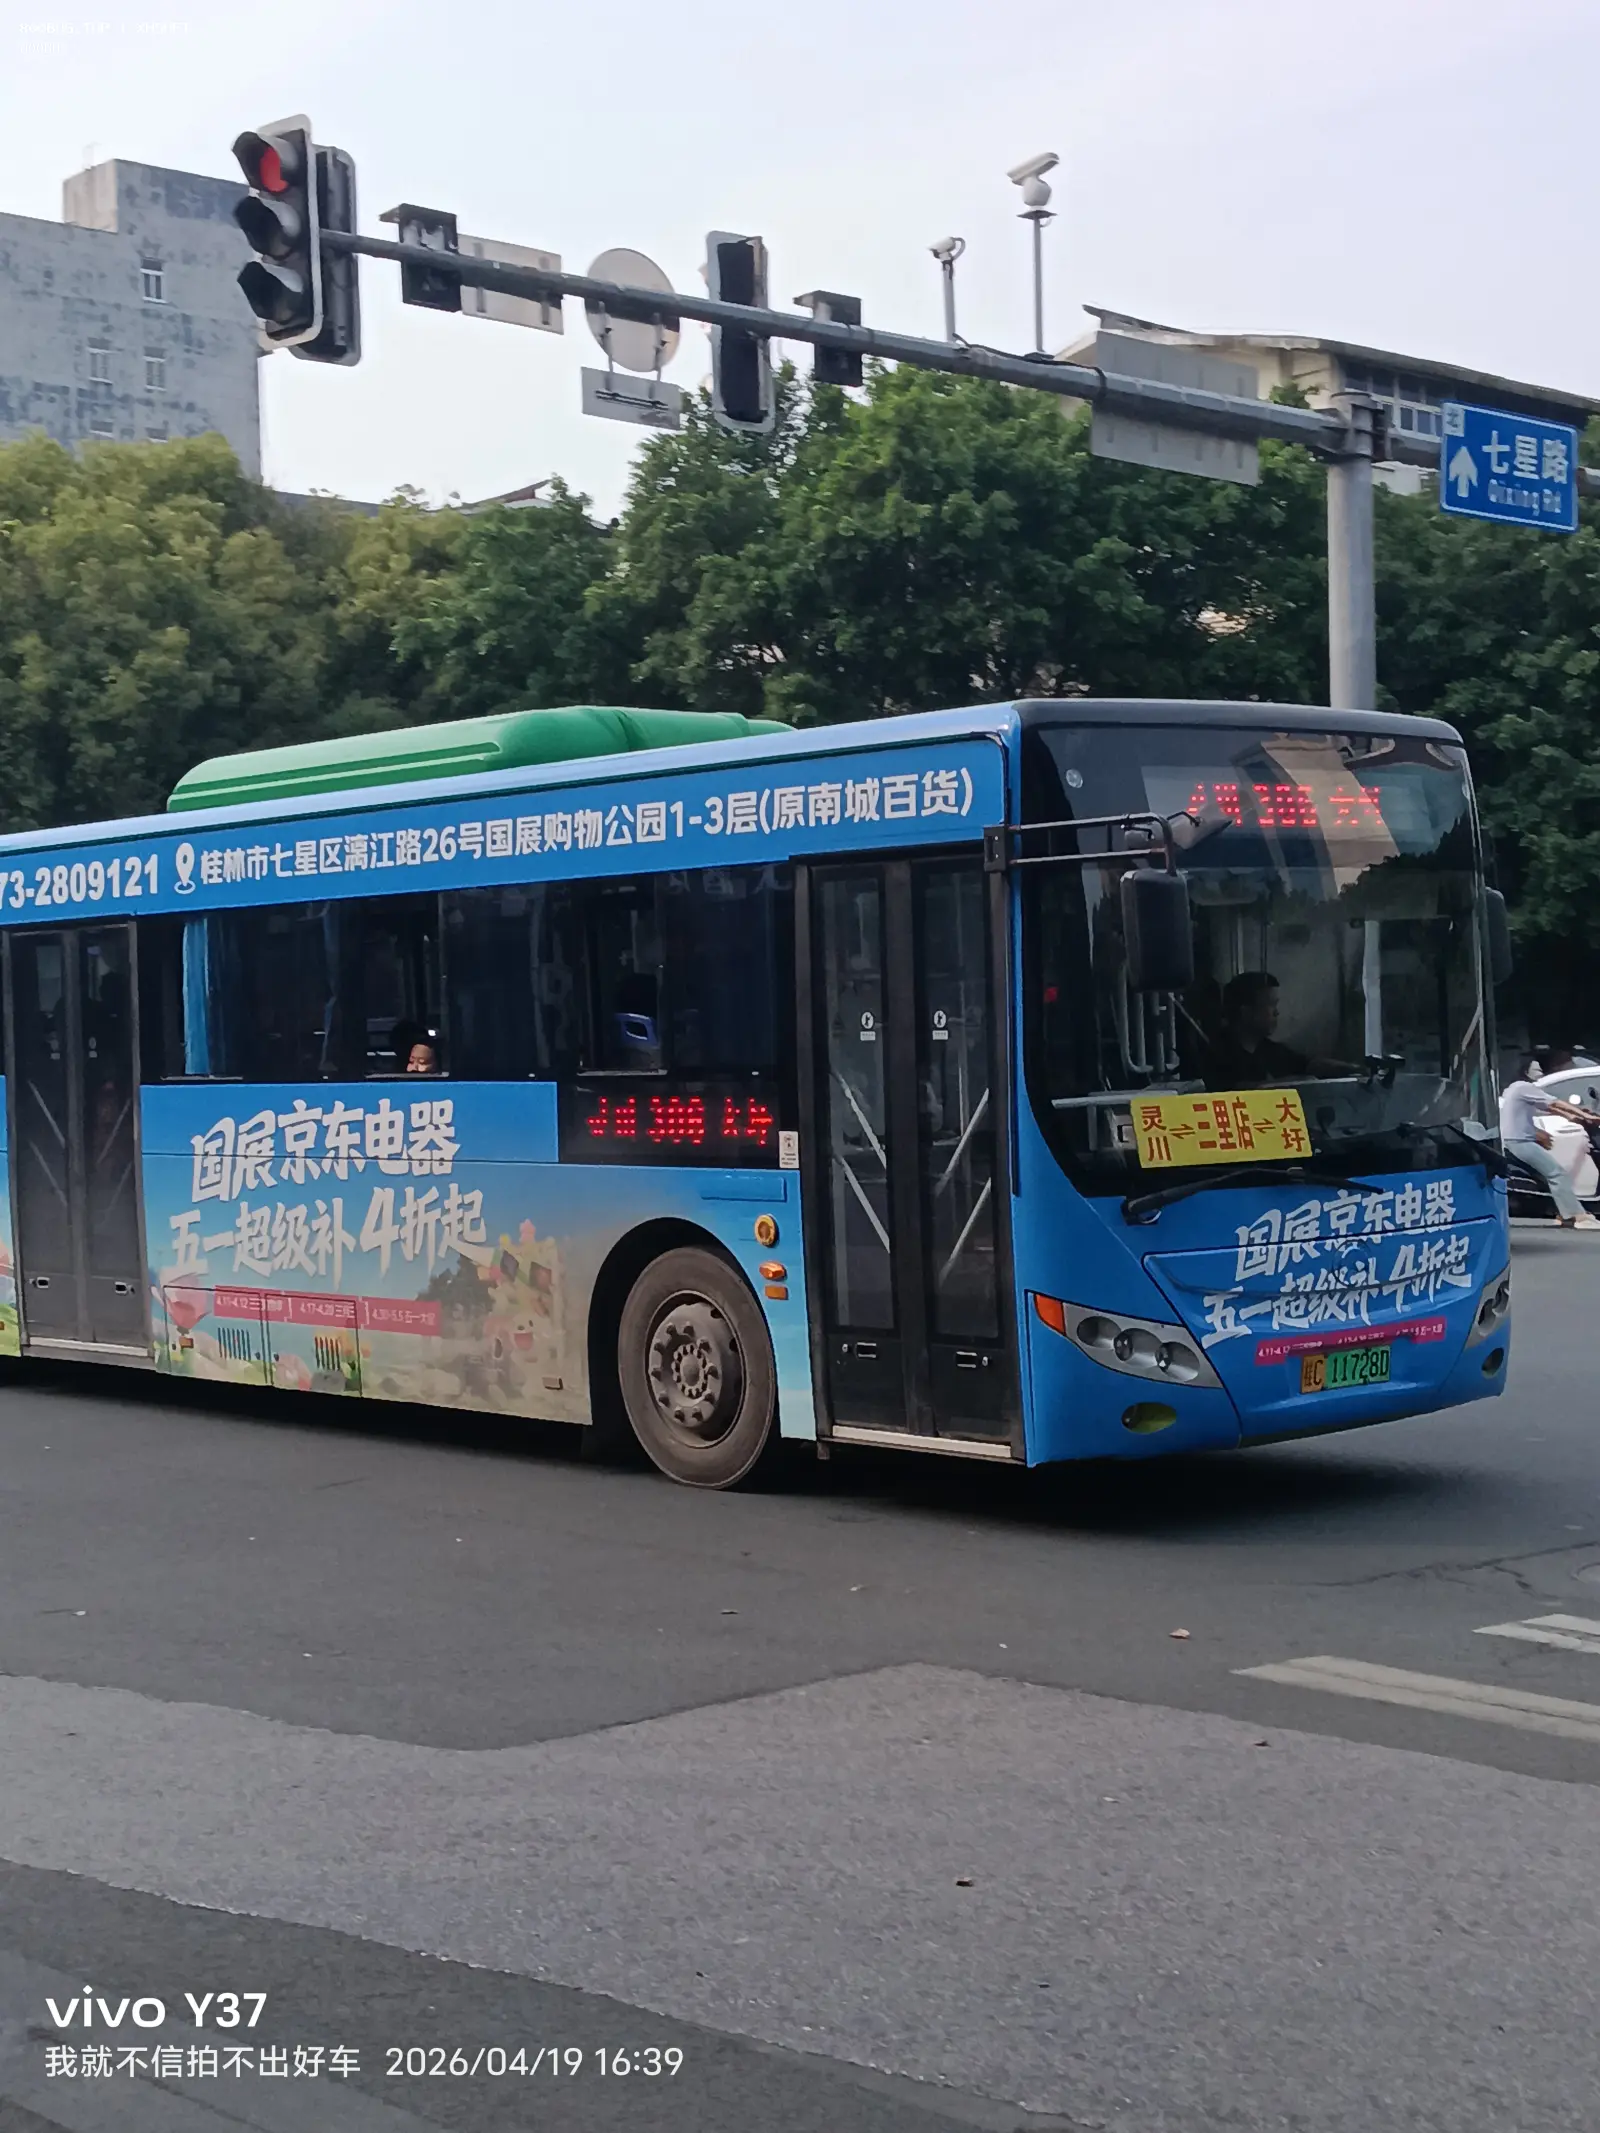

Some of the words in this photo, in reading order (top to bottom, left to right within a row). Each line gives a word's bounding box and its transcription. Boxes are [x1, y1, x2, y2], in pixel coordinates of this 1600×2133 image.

[1482, 430, 1569, 484] 七星路
[190, 1098, 461, 1203] 国展京东电器
[1140, 1105, 1172, 1162] 灵川
[1275, 1096, 1306, 1153] 大圩
[1233, 1179, 1457, 1282] 国展京东电器
